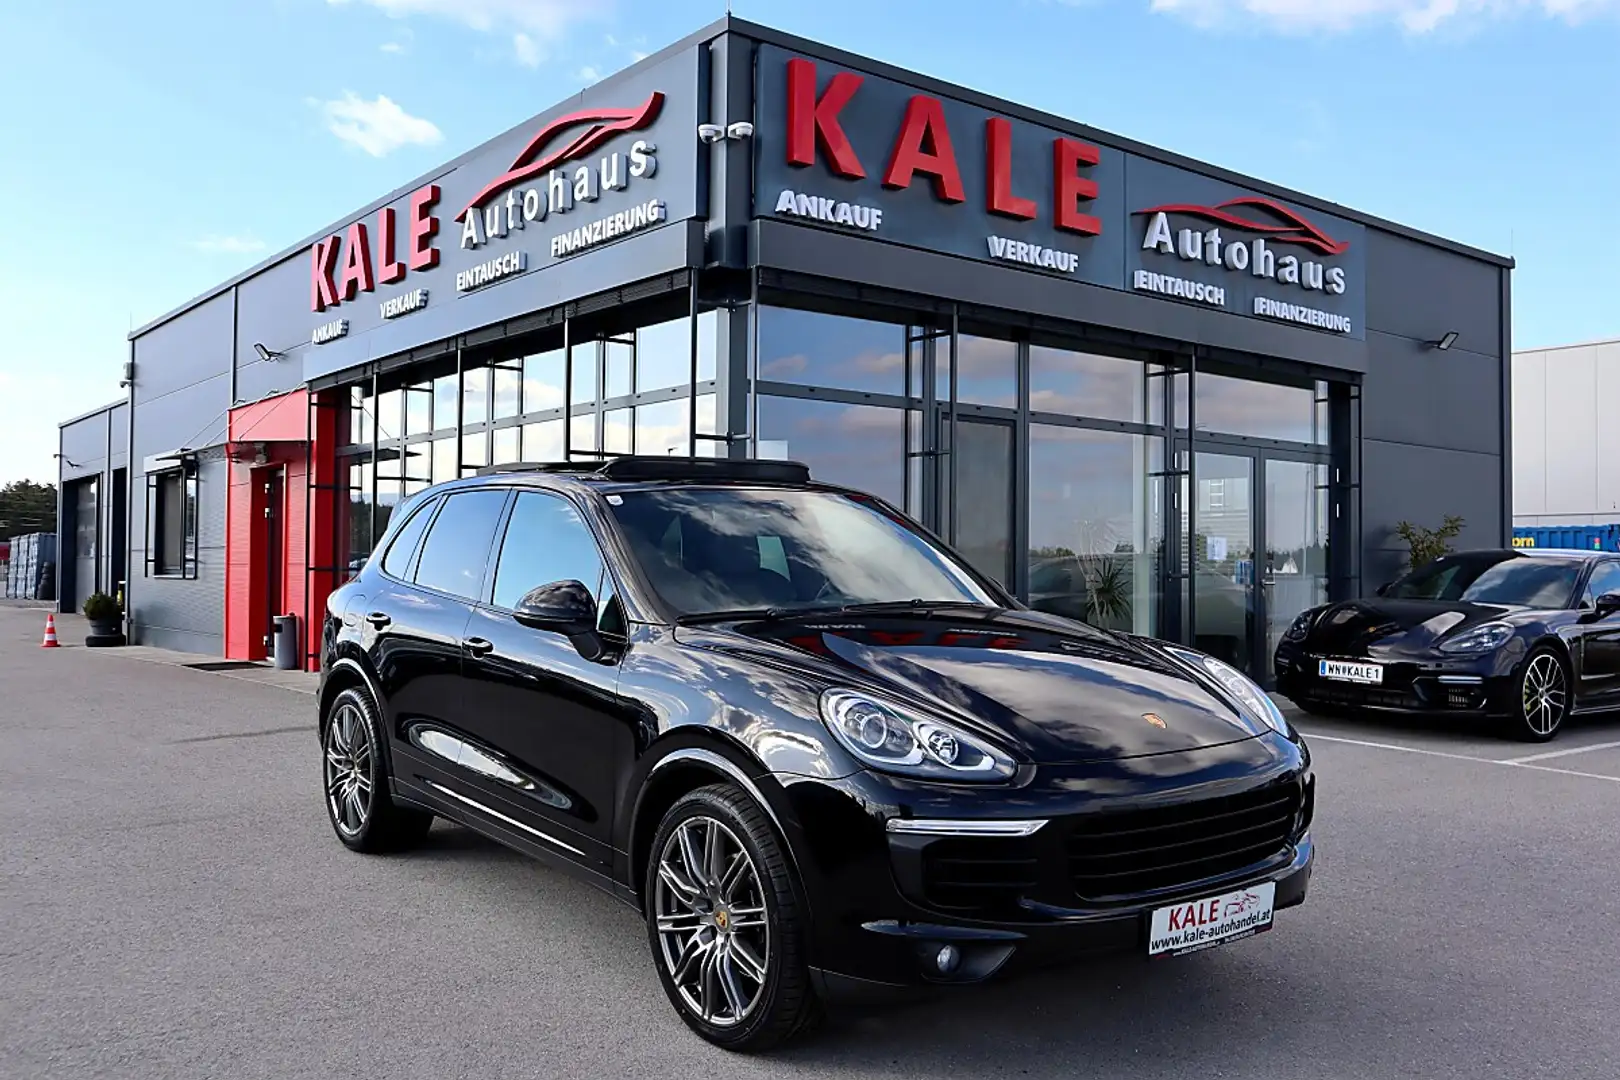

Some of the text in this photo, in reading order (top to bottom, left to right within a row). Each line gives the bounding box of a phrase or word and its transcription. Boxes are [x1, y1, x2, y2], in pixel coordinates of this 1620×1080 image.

[787, 57, 1100, 236] KALE
[461, 140, 658, 249] Autohaus
[775, 190, 882, 231] ANKAUF
[551, 199, 666, 257] FINANZIERUNG
[311, 185, 440, 312] KALE
[987, 235, 1079, 273] VERKAUF
[1143, 212, 1345, 294] Autohaus
[457, 251, 527, 291] EINTAUSCH
[1134, 270, 1224, 305] EINTAUSCH
[380, 289, 428, 319] VERKAUF
[1255, 298, 1351, 333] FINANZIERUNG
[312, 319, 349, 345] ANKAUF
[1151, 908, 1270, 950] www.kale-autohandel.at
[1168, 900, 1220, 931] KALE
